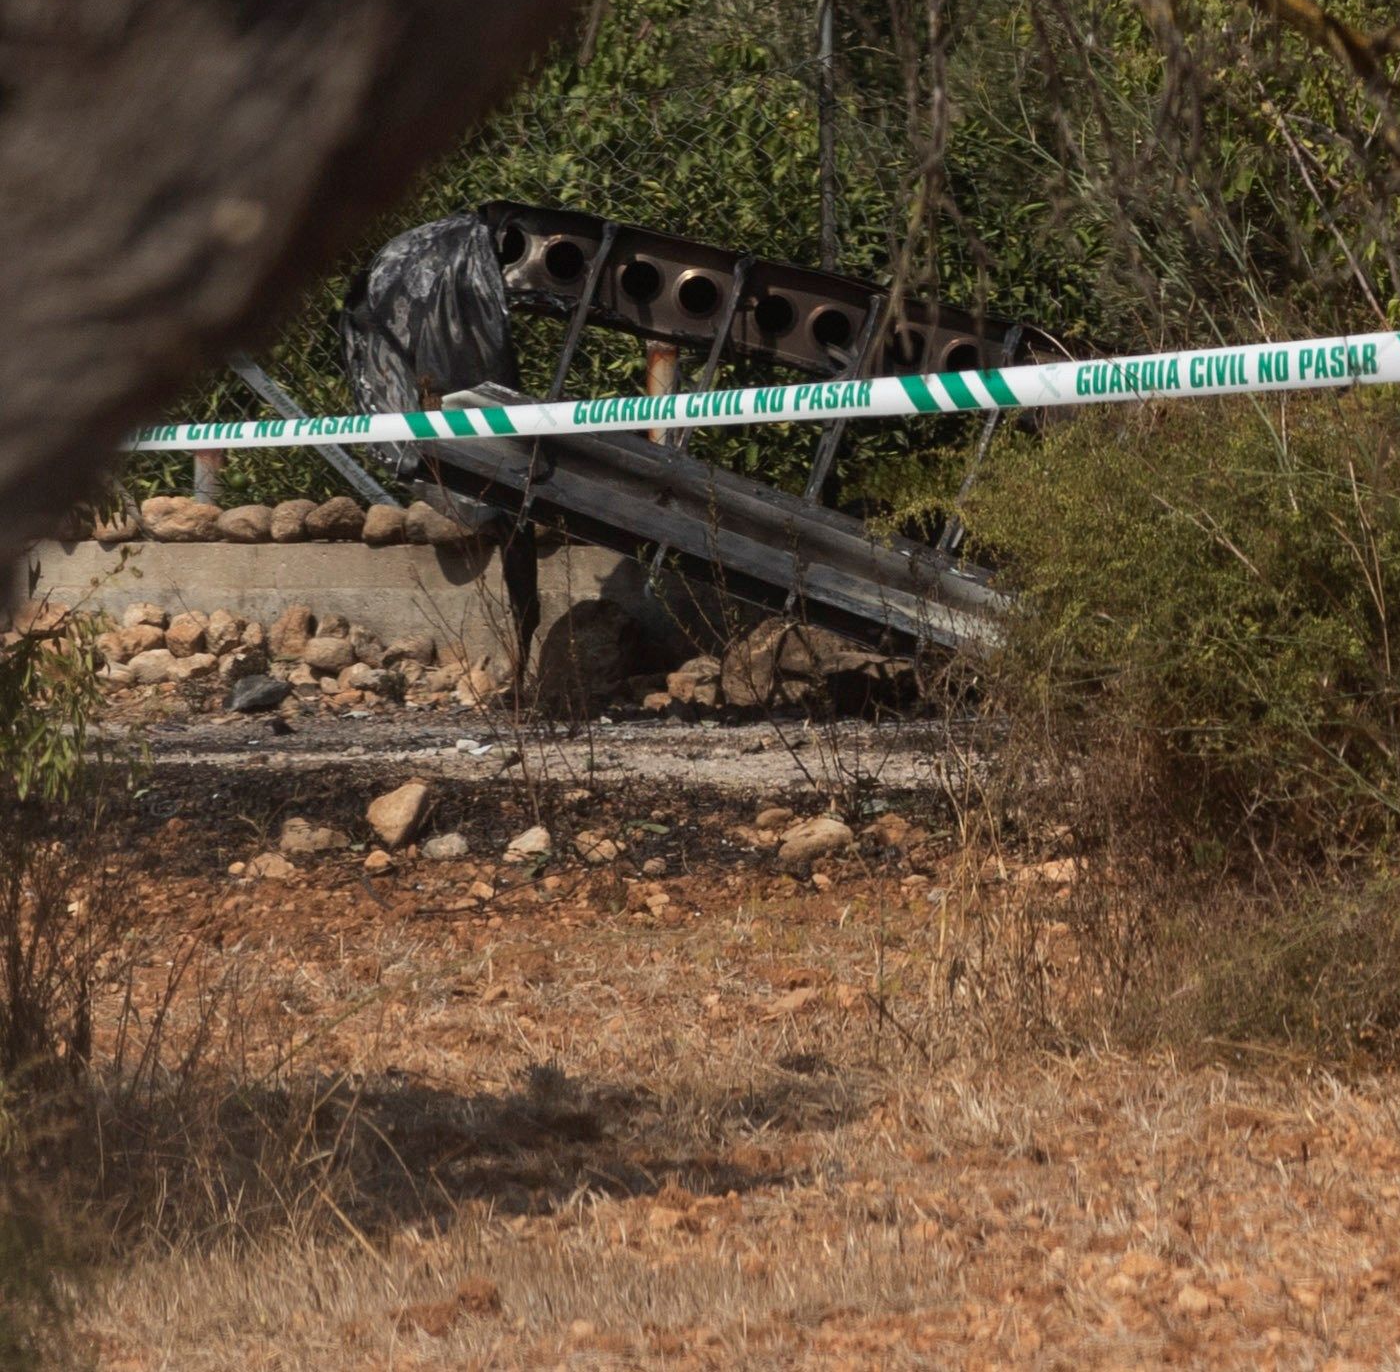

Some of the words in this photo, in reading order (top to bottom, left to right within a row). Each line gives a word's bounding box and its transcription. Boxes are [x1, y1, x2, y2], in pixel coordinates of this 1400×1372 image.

[1073, 357, 1181, 397] GUARDIA
[1188, 351, 1248, 390] CIVIL
[1256, 348, 1291, 384] NO
[1297, 340, 1379, 381] PASAR
[572, 394, 679, 427] GUARDIA
[685, 387, 744, 420] CIVIL
[753, 385, 789, 415] NO
[792, 380, 874, 411] PASAR
